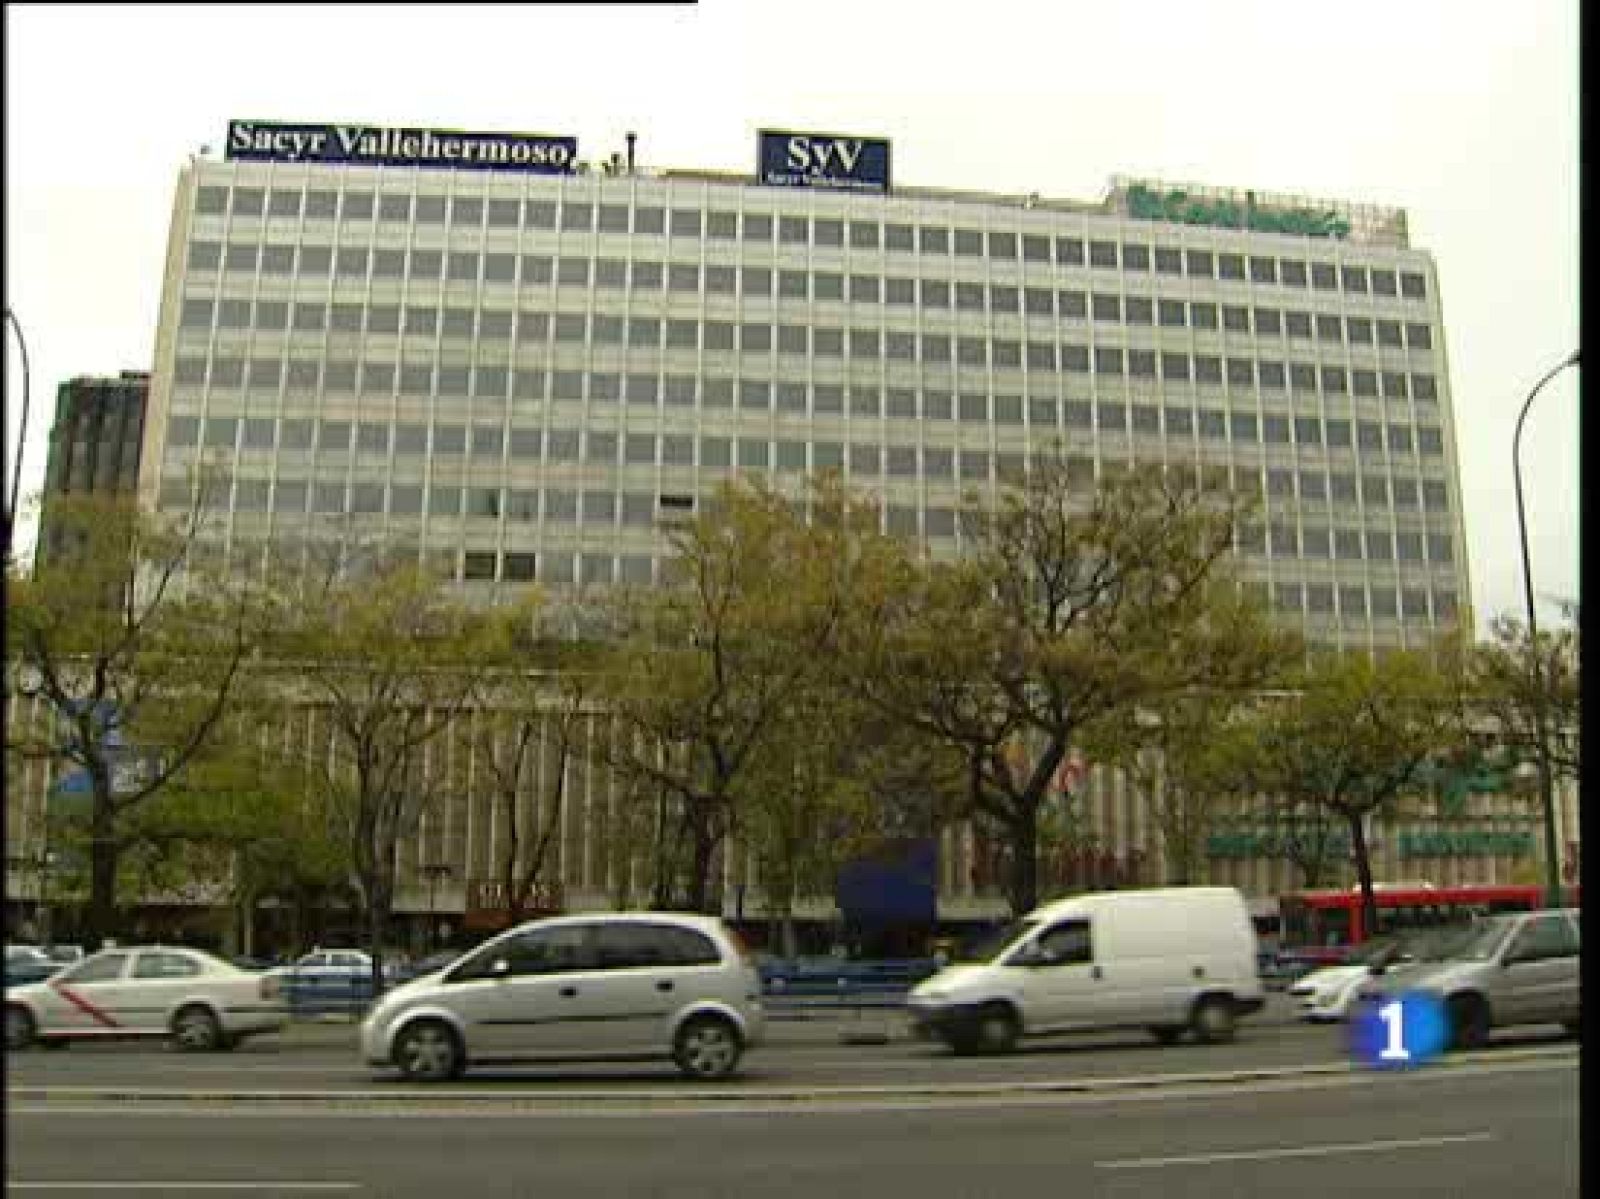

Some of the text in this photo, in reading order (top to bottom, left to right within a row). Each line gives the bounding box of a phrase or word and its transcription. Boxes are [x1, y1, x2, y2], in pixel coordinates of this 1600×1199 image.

[231, 122, 570, 166] Sacyr Vallehermoso
[788, 136, 862, 175] SyV
